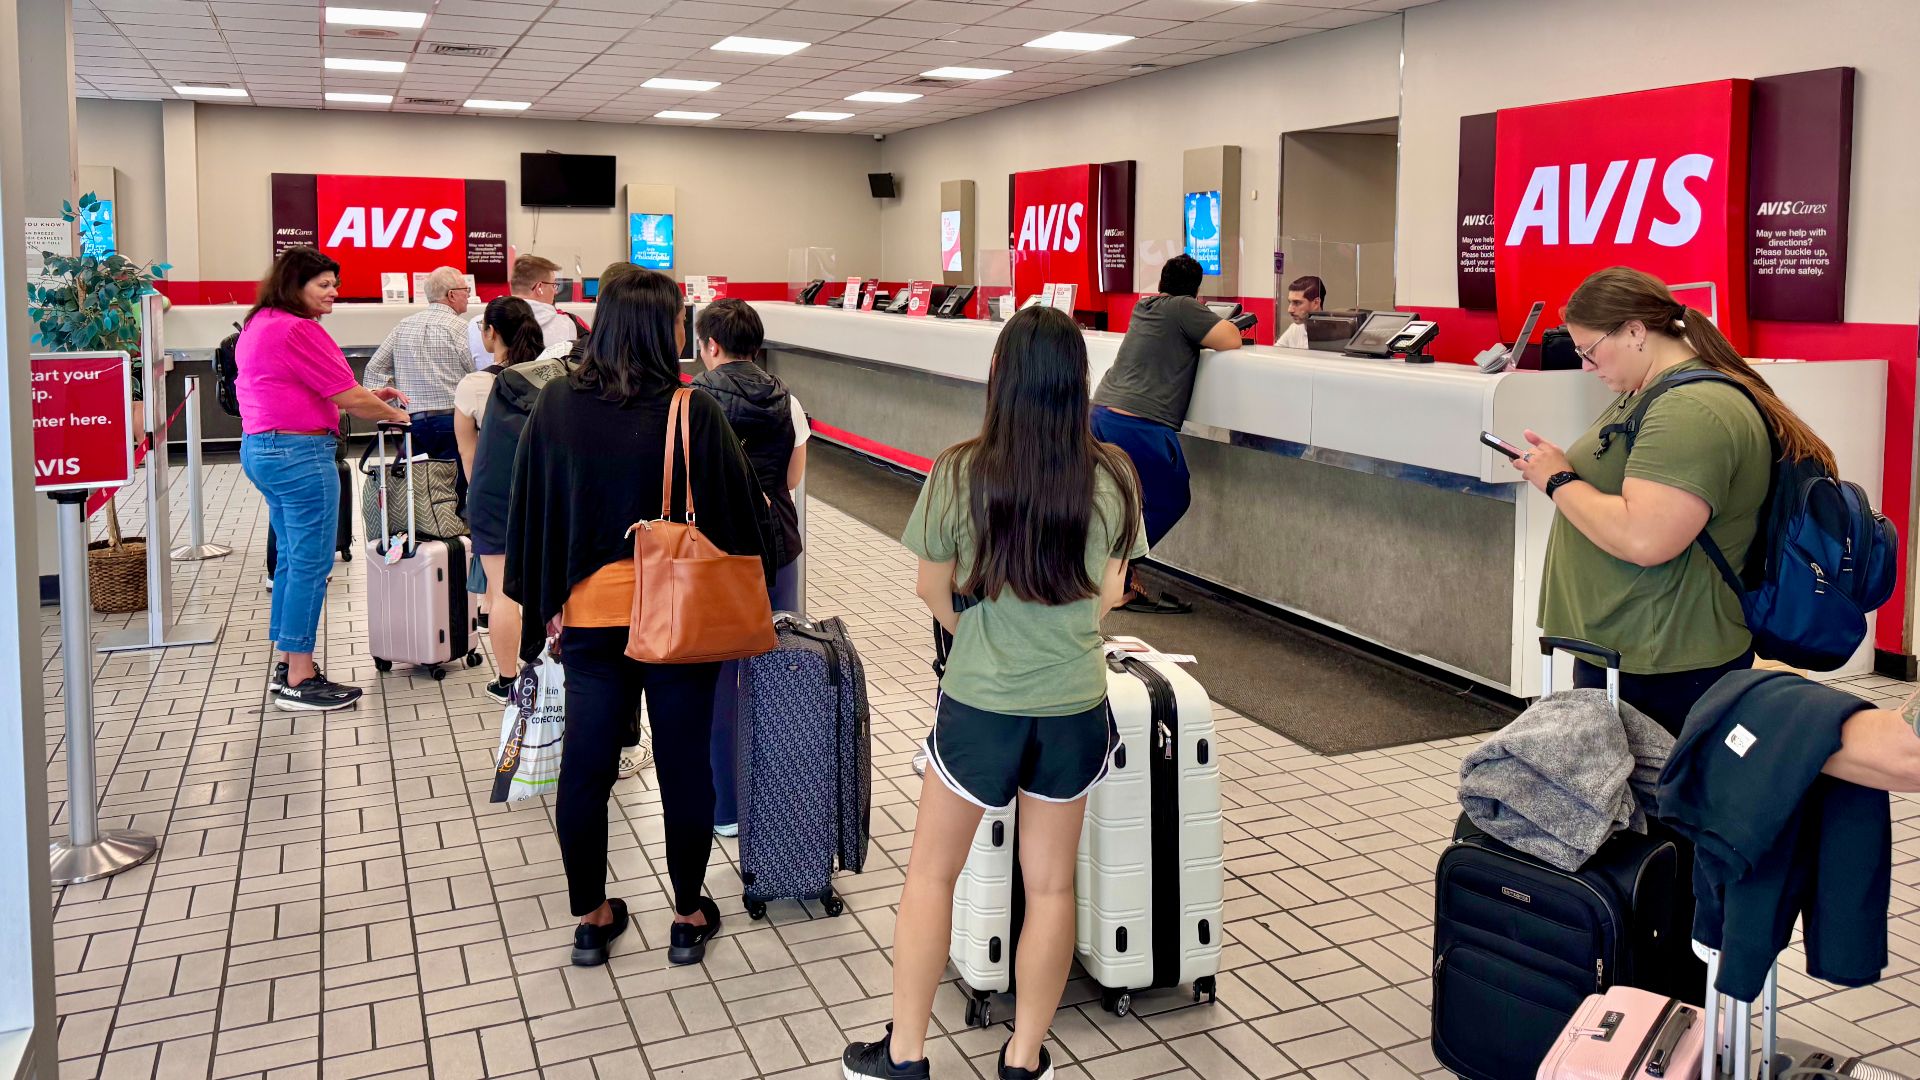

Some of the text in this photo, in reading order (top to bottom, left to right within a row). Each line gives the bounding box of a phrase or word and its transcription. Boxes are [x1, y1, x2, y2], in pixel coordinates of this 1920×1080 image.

[1505, 153, 1714, 247] AVIS
[326, 206, 458, 250] AVIS
[1017, 202, 1084, 253] AVIS
[1756, 229, 1773, 238] May
[1789, 228, 1807, 238] help
[1809, 227, 1827, 236] with
[1768, 237, 1813, 247] directions?
[1755, 247, 1828, 258] Please buckle up,
[1752, 257, 1830, 267] adjust your mirrors
[1758, 265, 1825, 277] and drive safely.
[63, 370, 101, 384] your
[70, 412, 112, 426] here.
[280, 686, 302, 698] HOKA
